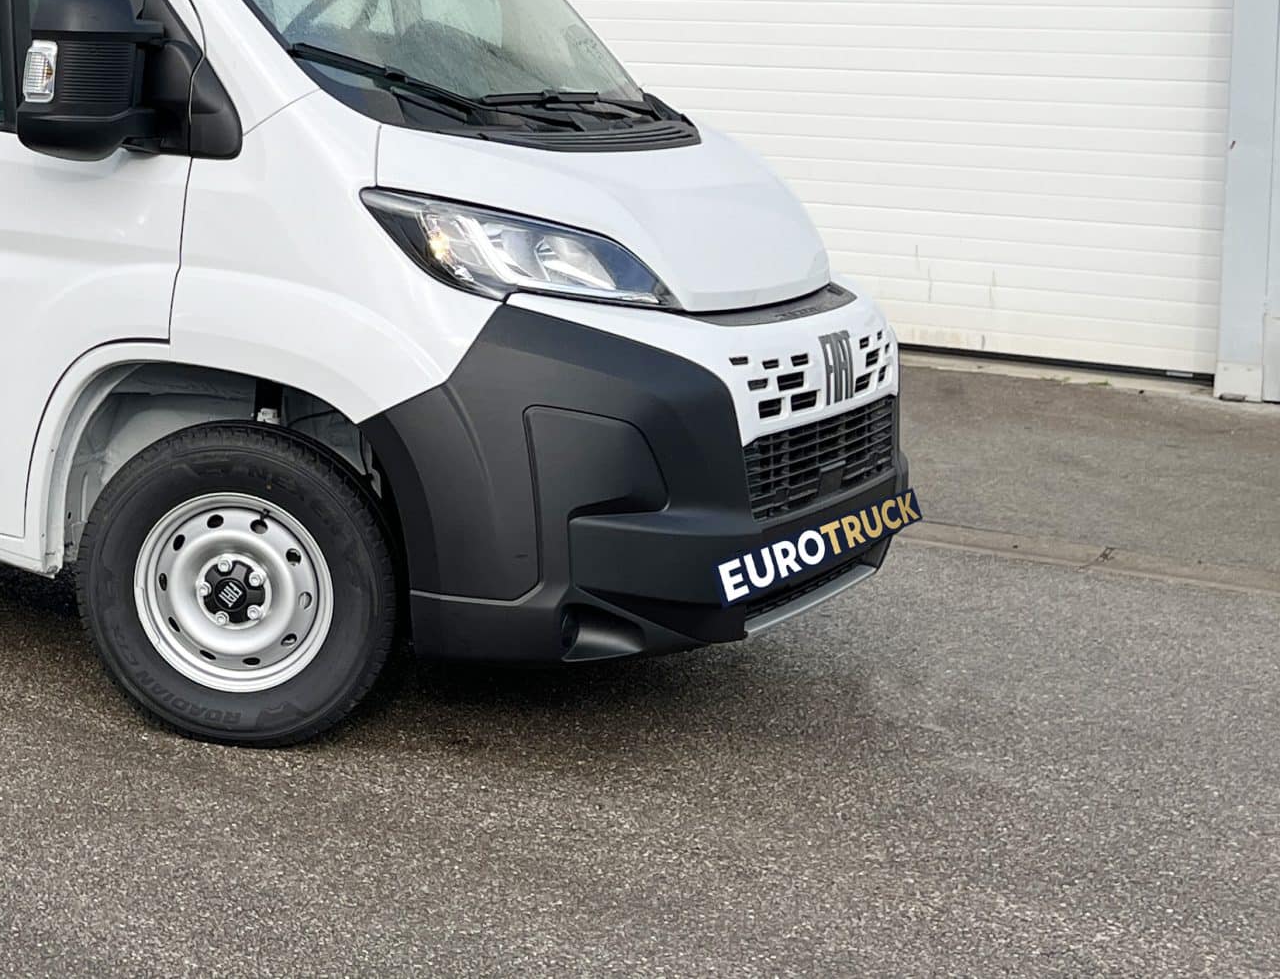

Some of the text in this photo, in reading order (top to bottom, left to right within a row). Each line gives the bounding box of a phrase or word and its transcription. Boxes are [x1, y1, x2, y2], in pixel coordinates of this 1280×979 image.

[818, 329, 855, 406] FIAT
[717, 491, 921, 603] EUROTRUCK
[217, 581, 243, 608] FIAT
